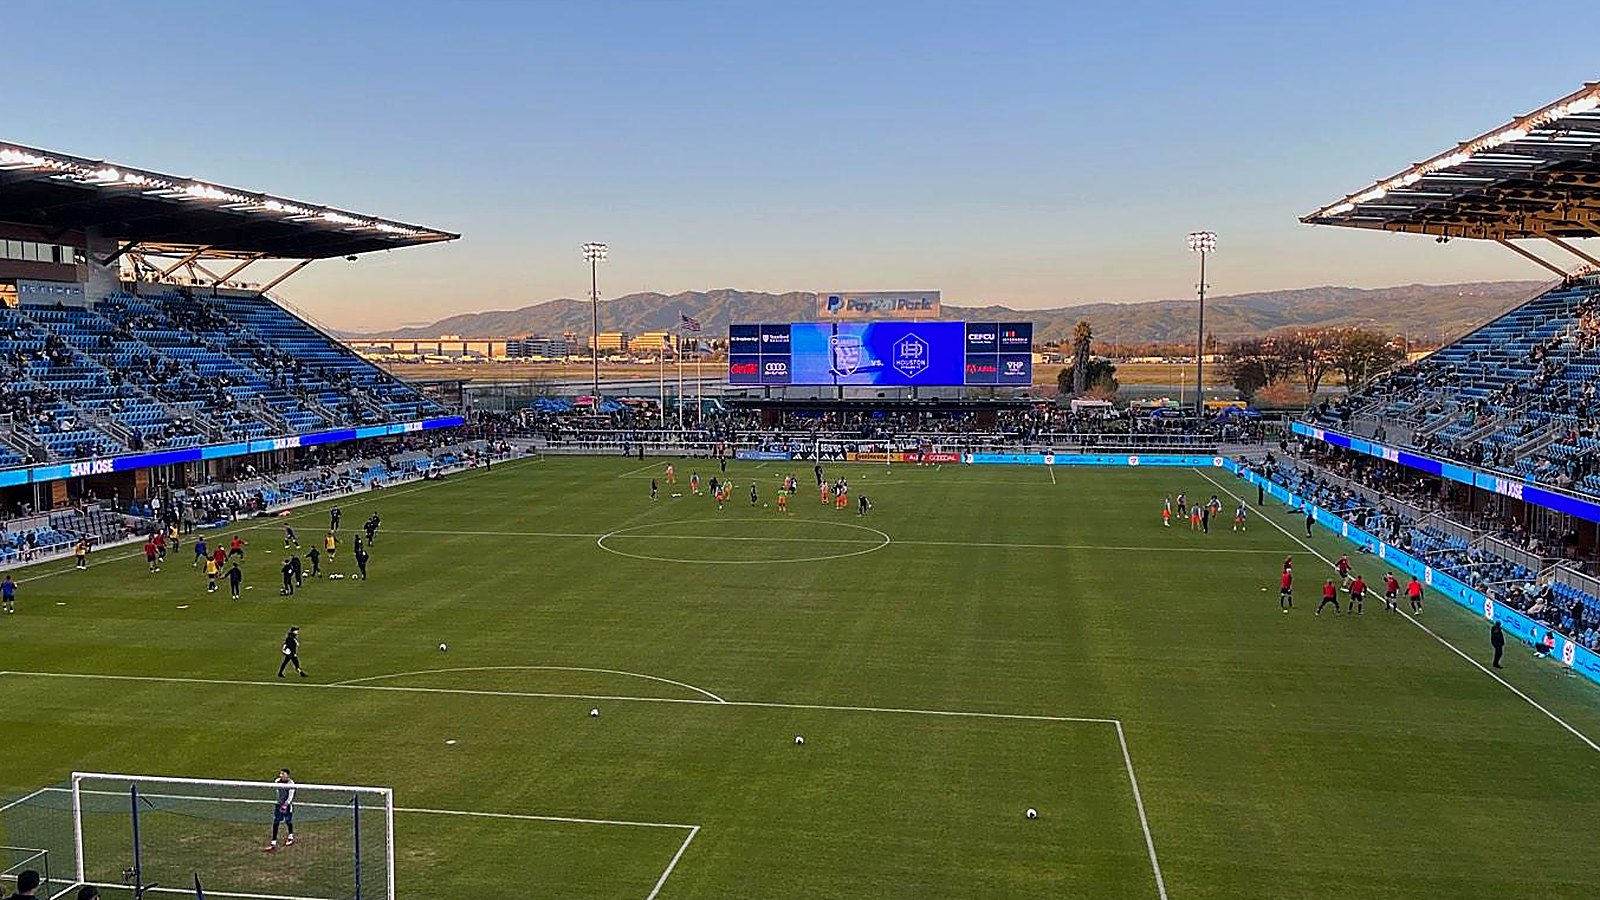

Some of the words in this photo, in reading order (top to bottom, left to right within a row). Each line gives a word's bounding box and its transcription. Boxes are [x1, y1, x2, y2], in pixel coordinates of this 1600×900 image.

[897, 298, 933, 311] Park
[70, 461, 91, 477] SAN
[92, 459, 114, 475] JOSE
[1508, 479, 1523, 500] JOSE
